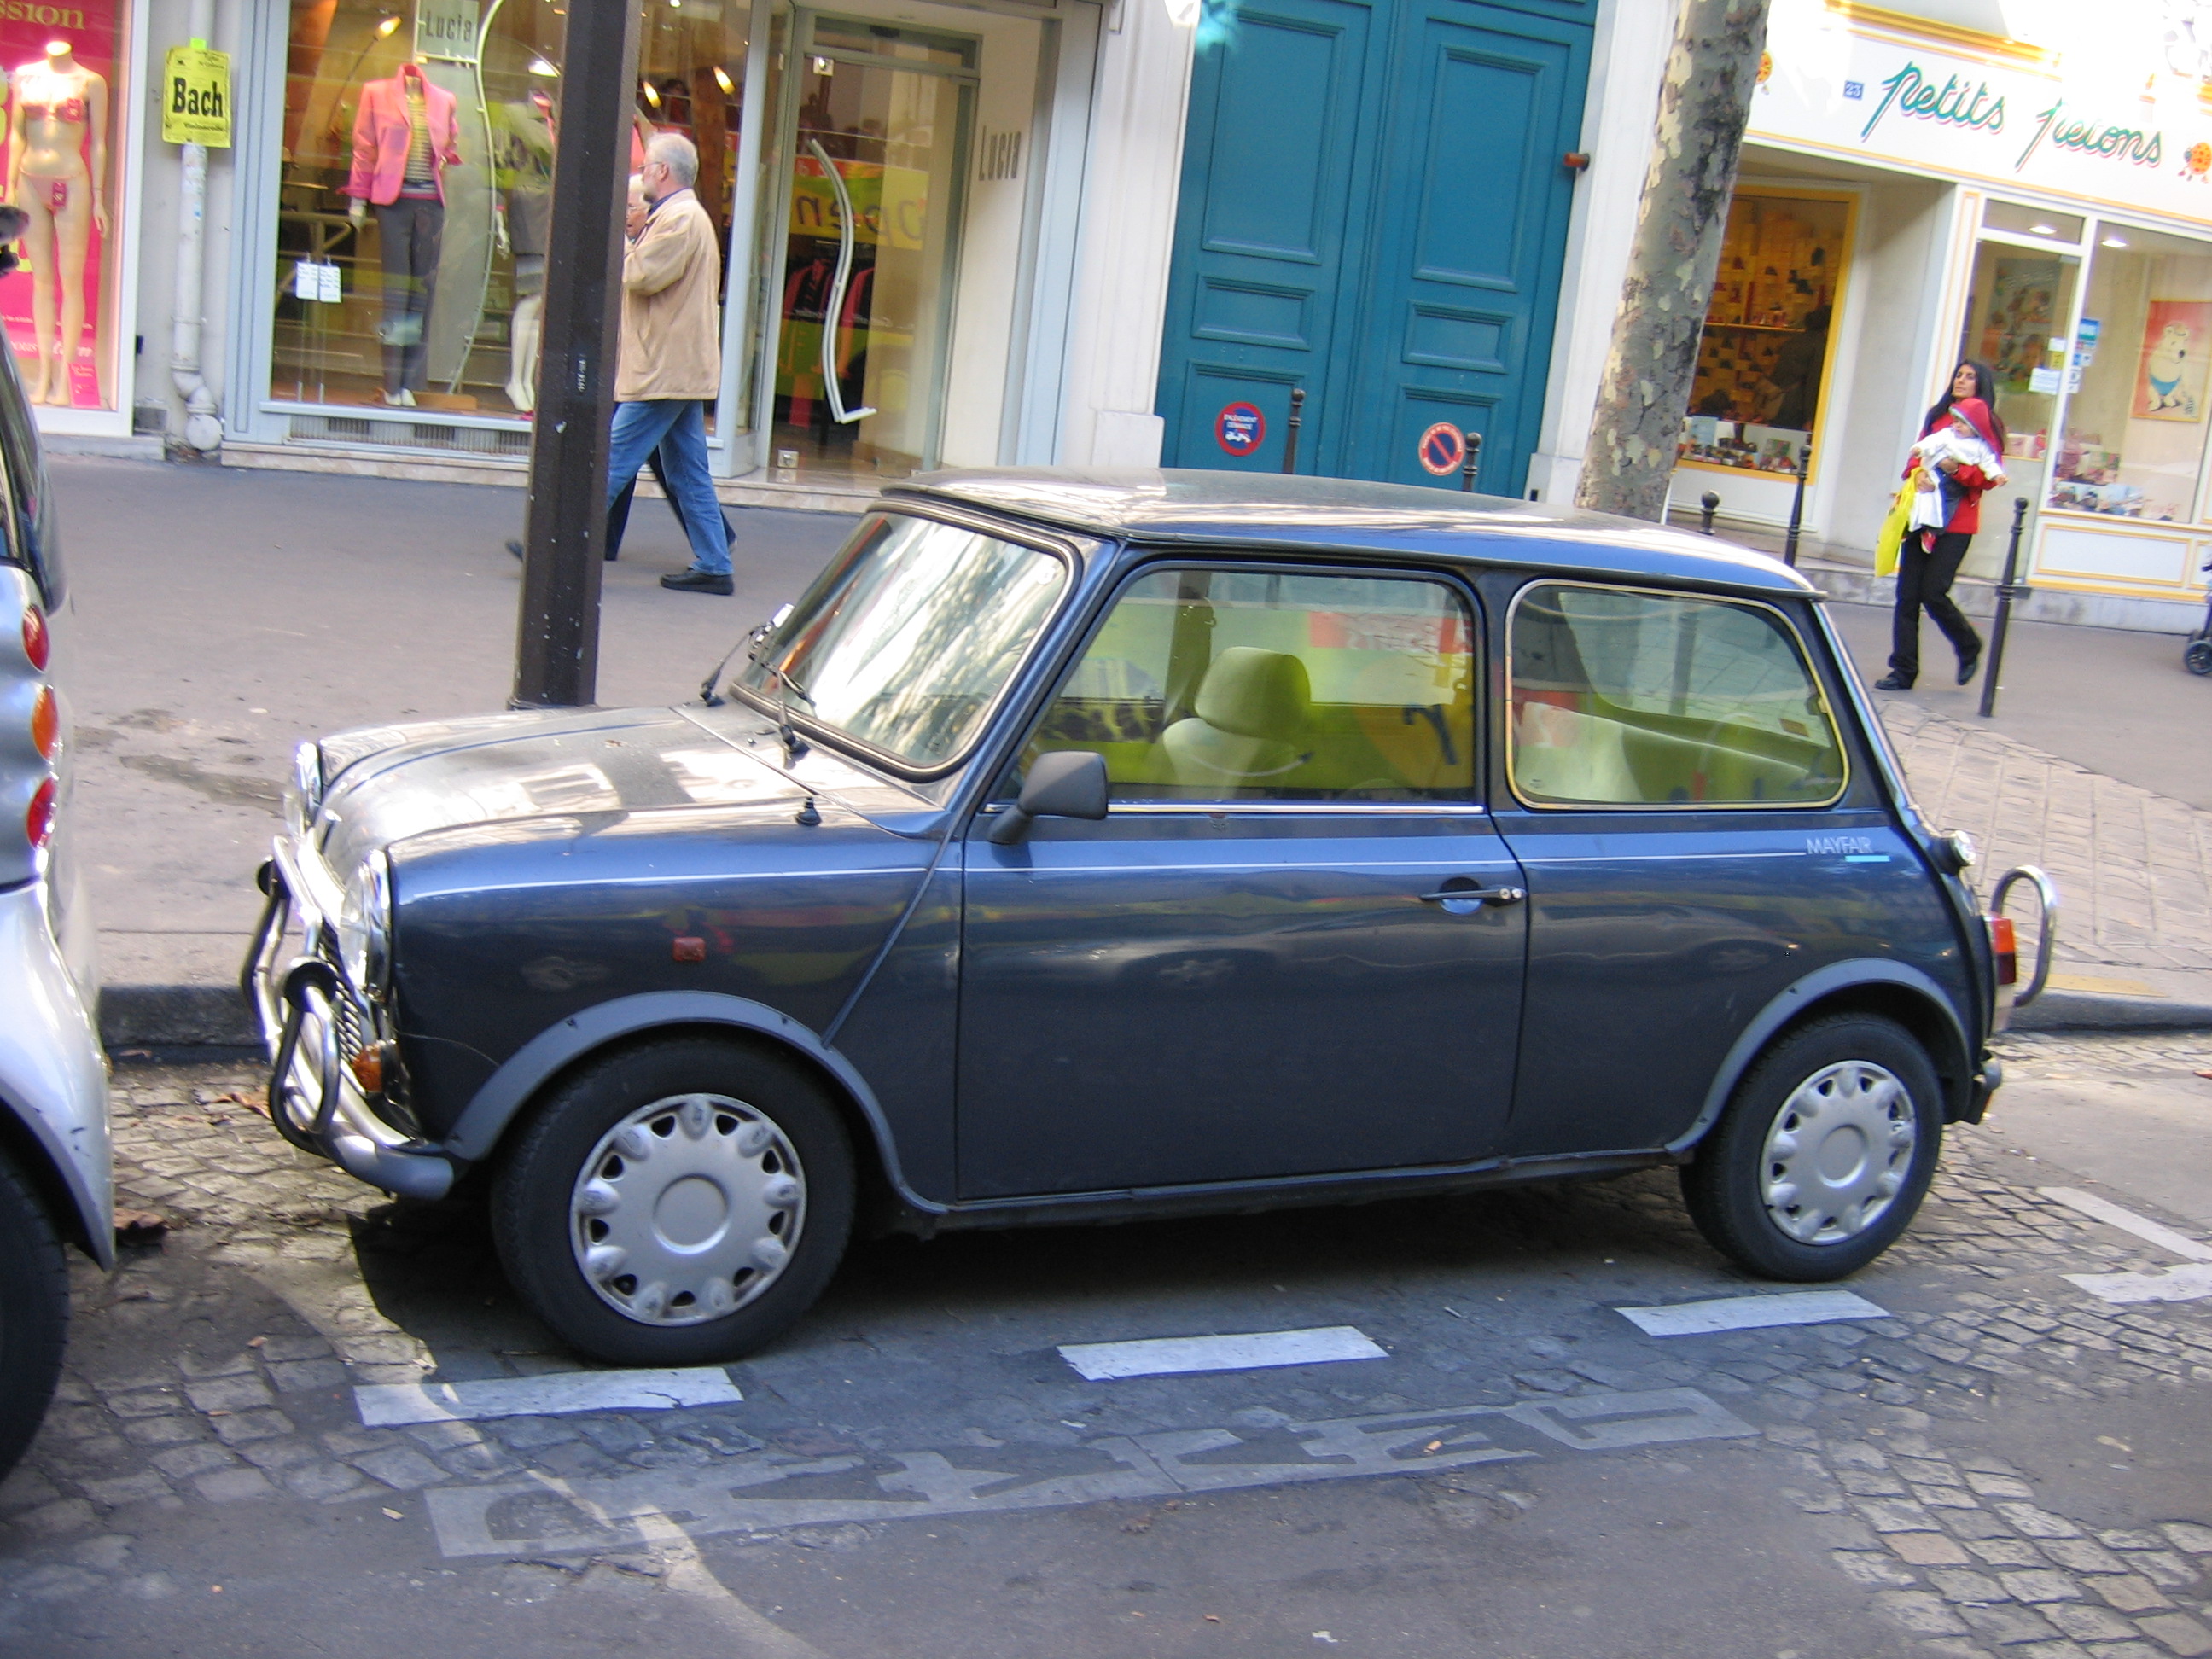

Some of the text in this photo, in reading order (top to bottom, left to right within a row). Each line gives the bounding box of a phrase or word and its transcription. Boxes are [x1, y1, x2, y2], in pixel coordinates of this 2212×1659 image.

[426, 10, 473, 43] Lucia
[172, 77, 224, 117] Bach
[1845, 83, 1862, 97] 23
